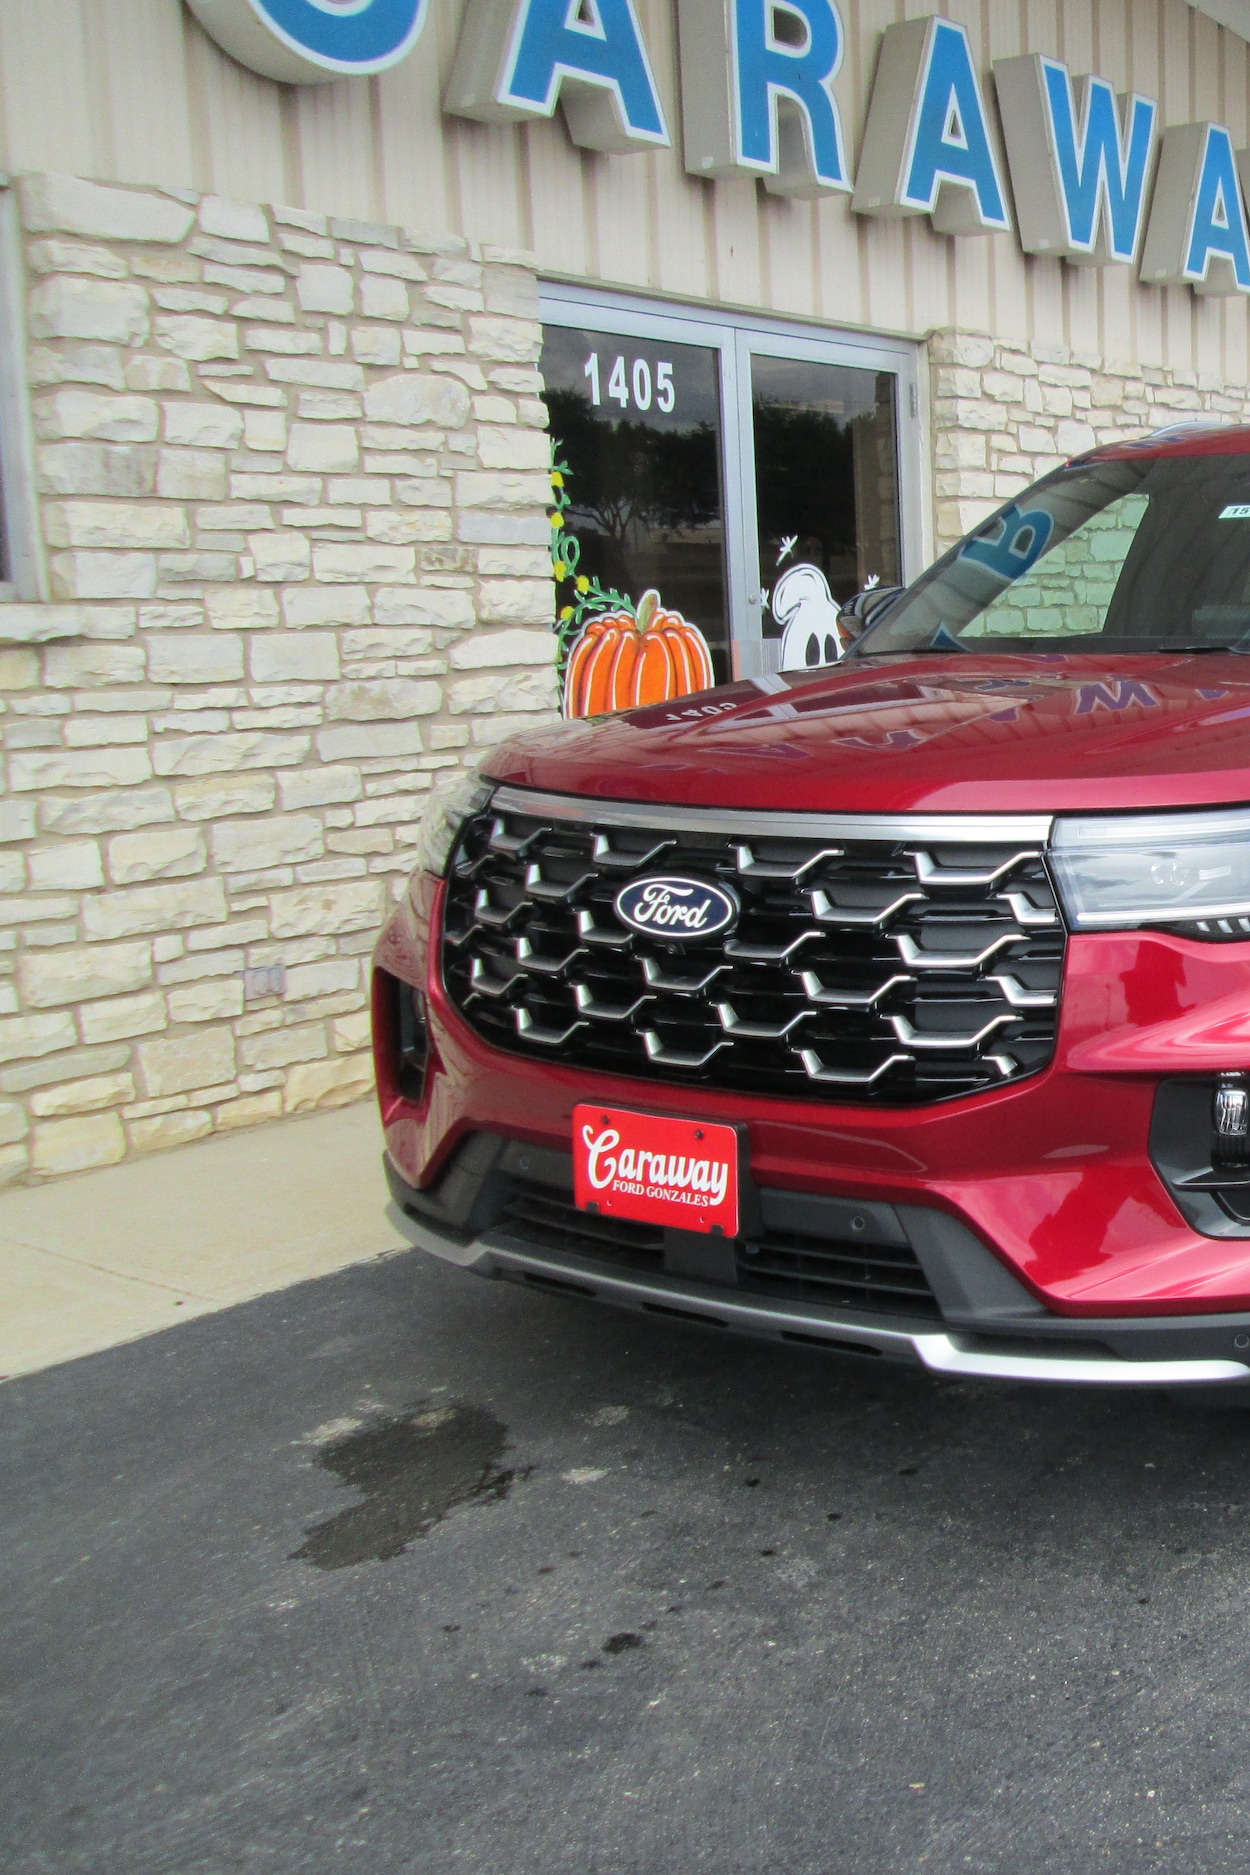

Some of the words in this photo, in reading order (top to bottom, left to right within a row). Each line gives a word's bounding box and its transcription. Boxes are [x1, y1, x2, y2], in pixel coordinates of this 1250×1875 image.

[584, 352, 676, 413] 1405
[633, 883, 712, 929] Ford
[582, 1124, 729, 1206] Caraway
[612, 1179, 645, 1196] FORD
[646, 1186, 709, 1208] GONZALES
